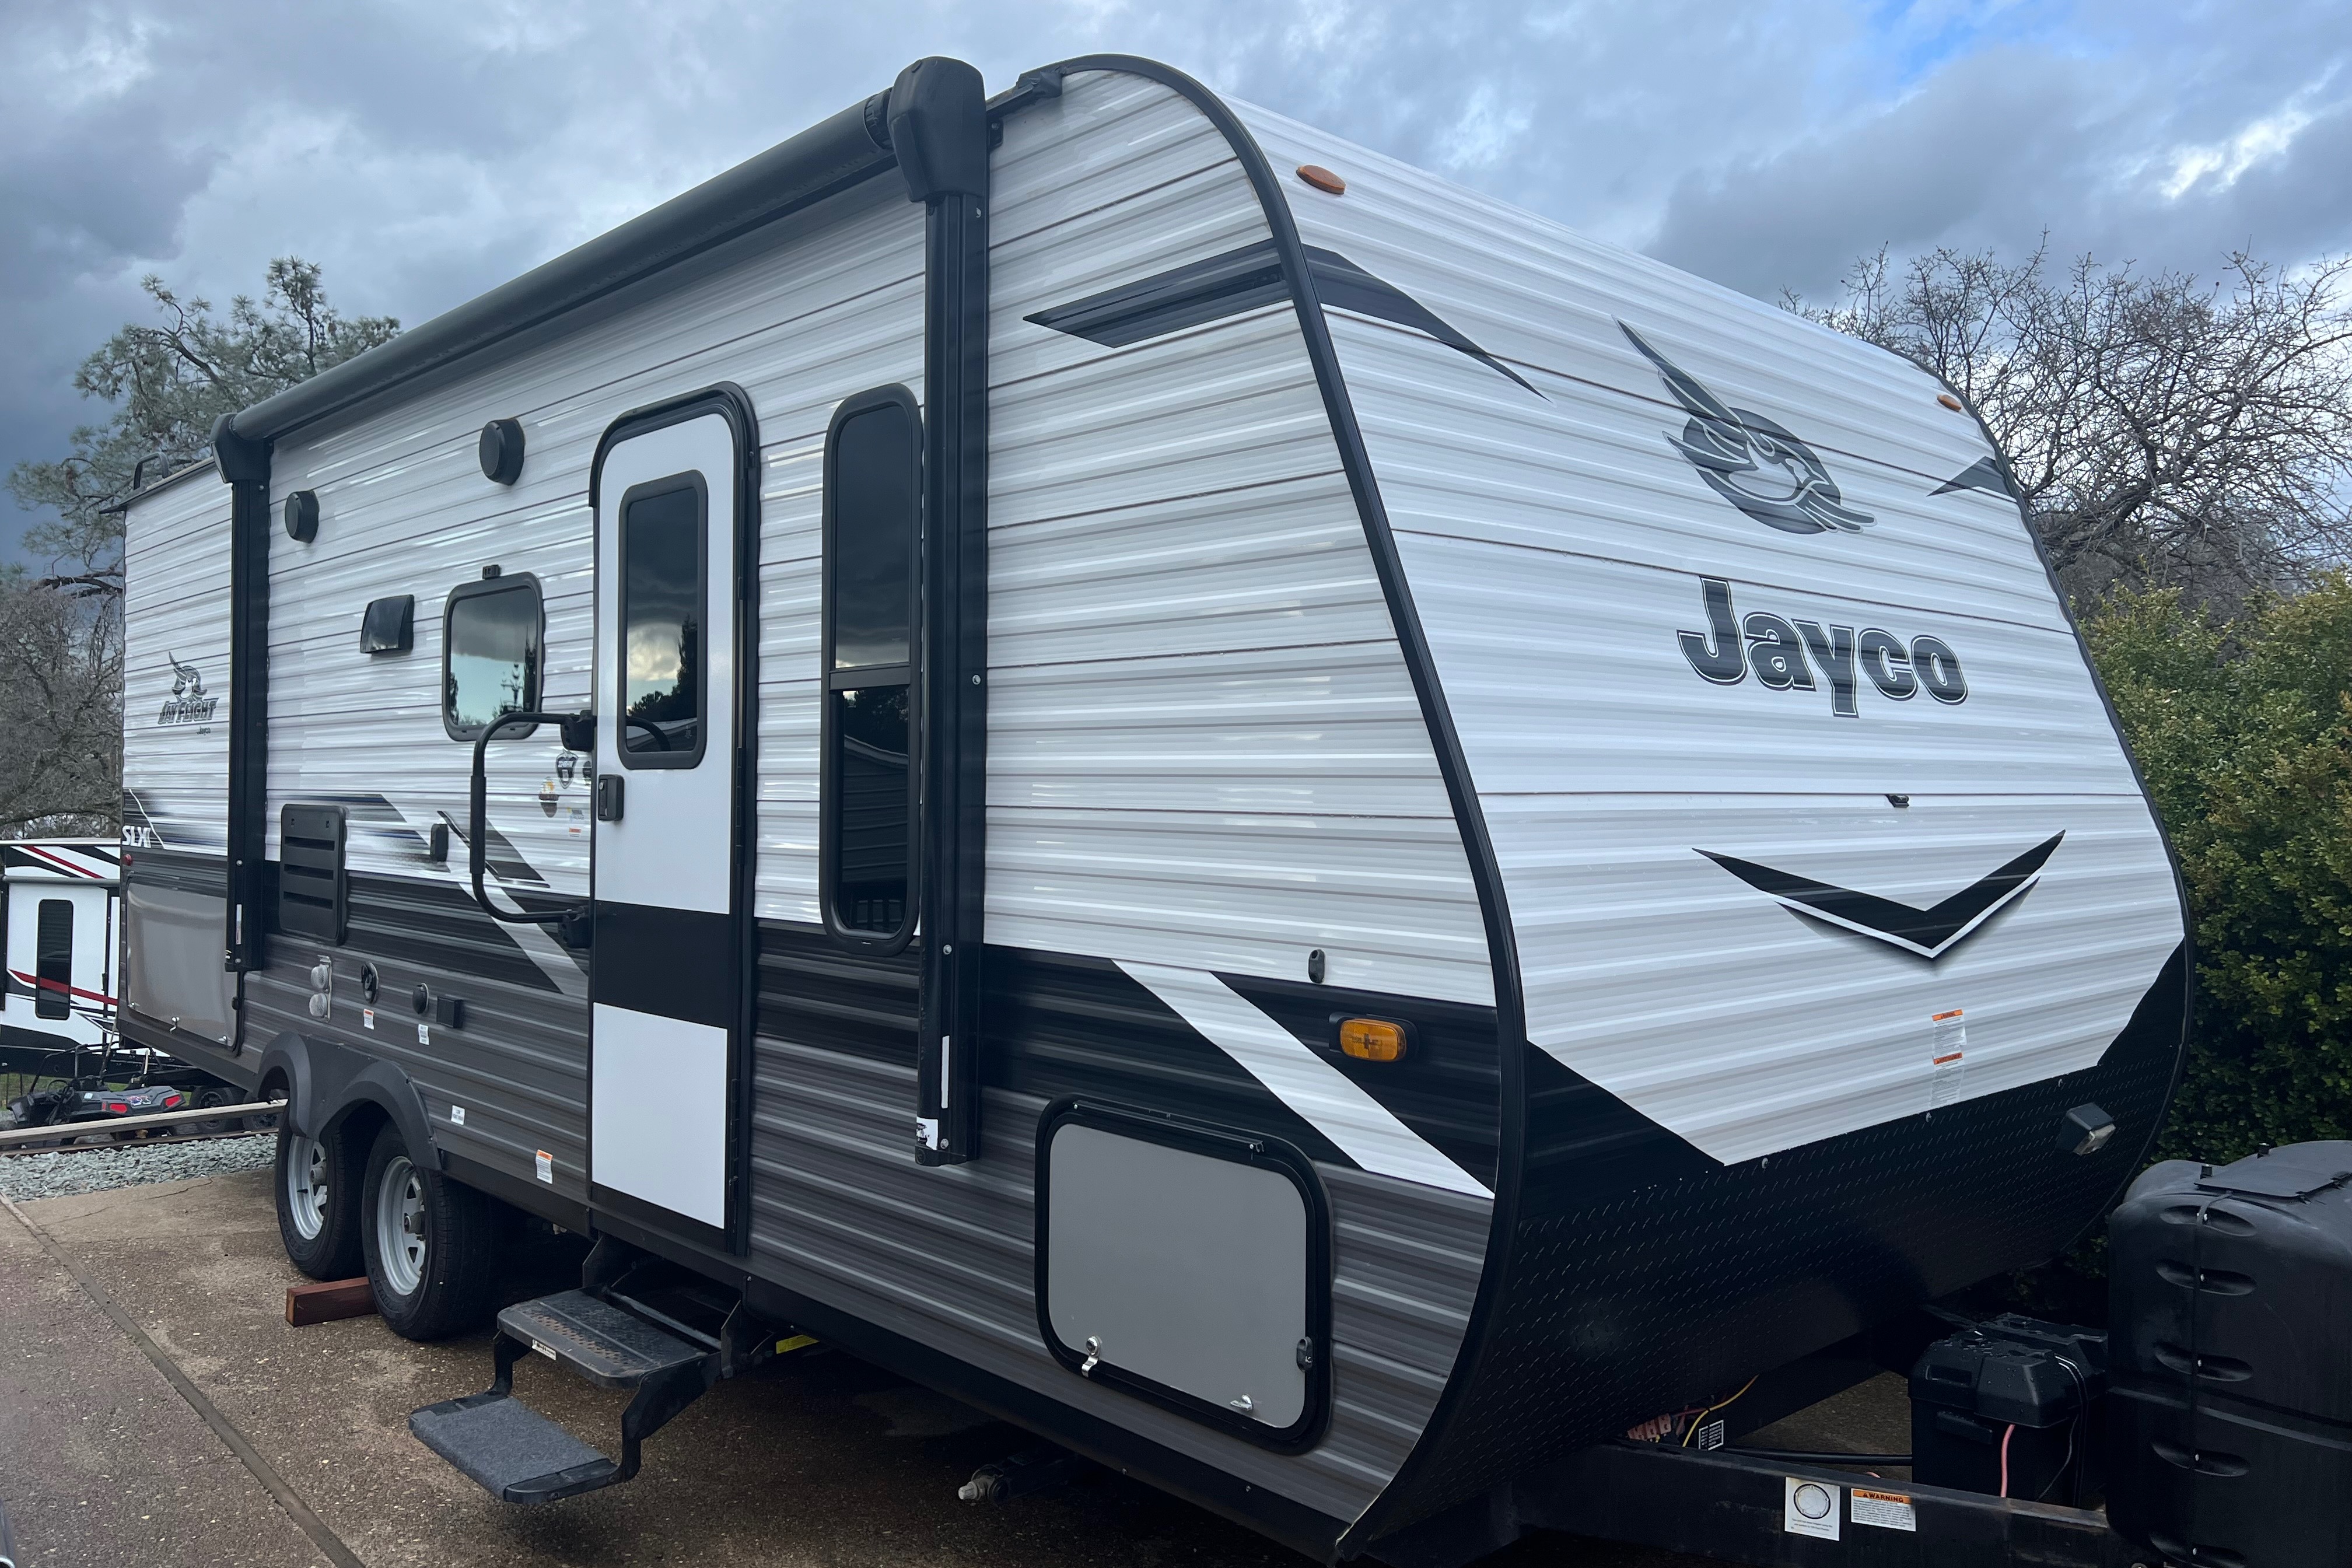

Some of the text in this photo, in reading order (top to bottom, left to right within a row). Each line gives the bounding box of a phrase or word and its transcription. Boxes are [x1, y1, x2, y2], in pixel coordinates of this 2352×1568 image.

[1677, 575, 1969, 719] Jayco
[122, 825, 151, 848] SLX
[1868, 1492, 1904, 1503] WARNING
